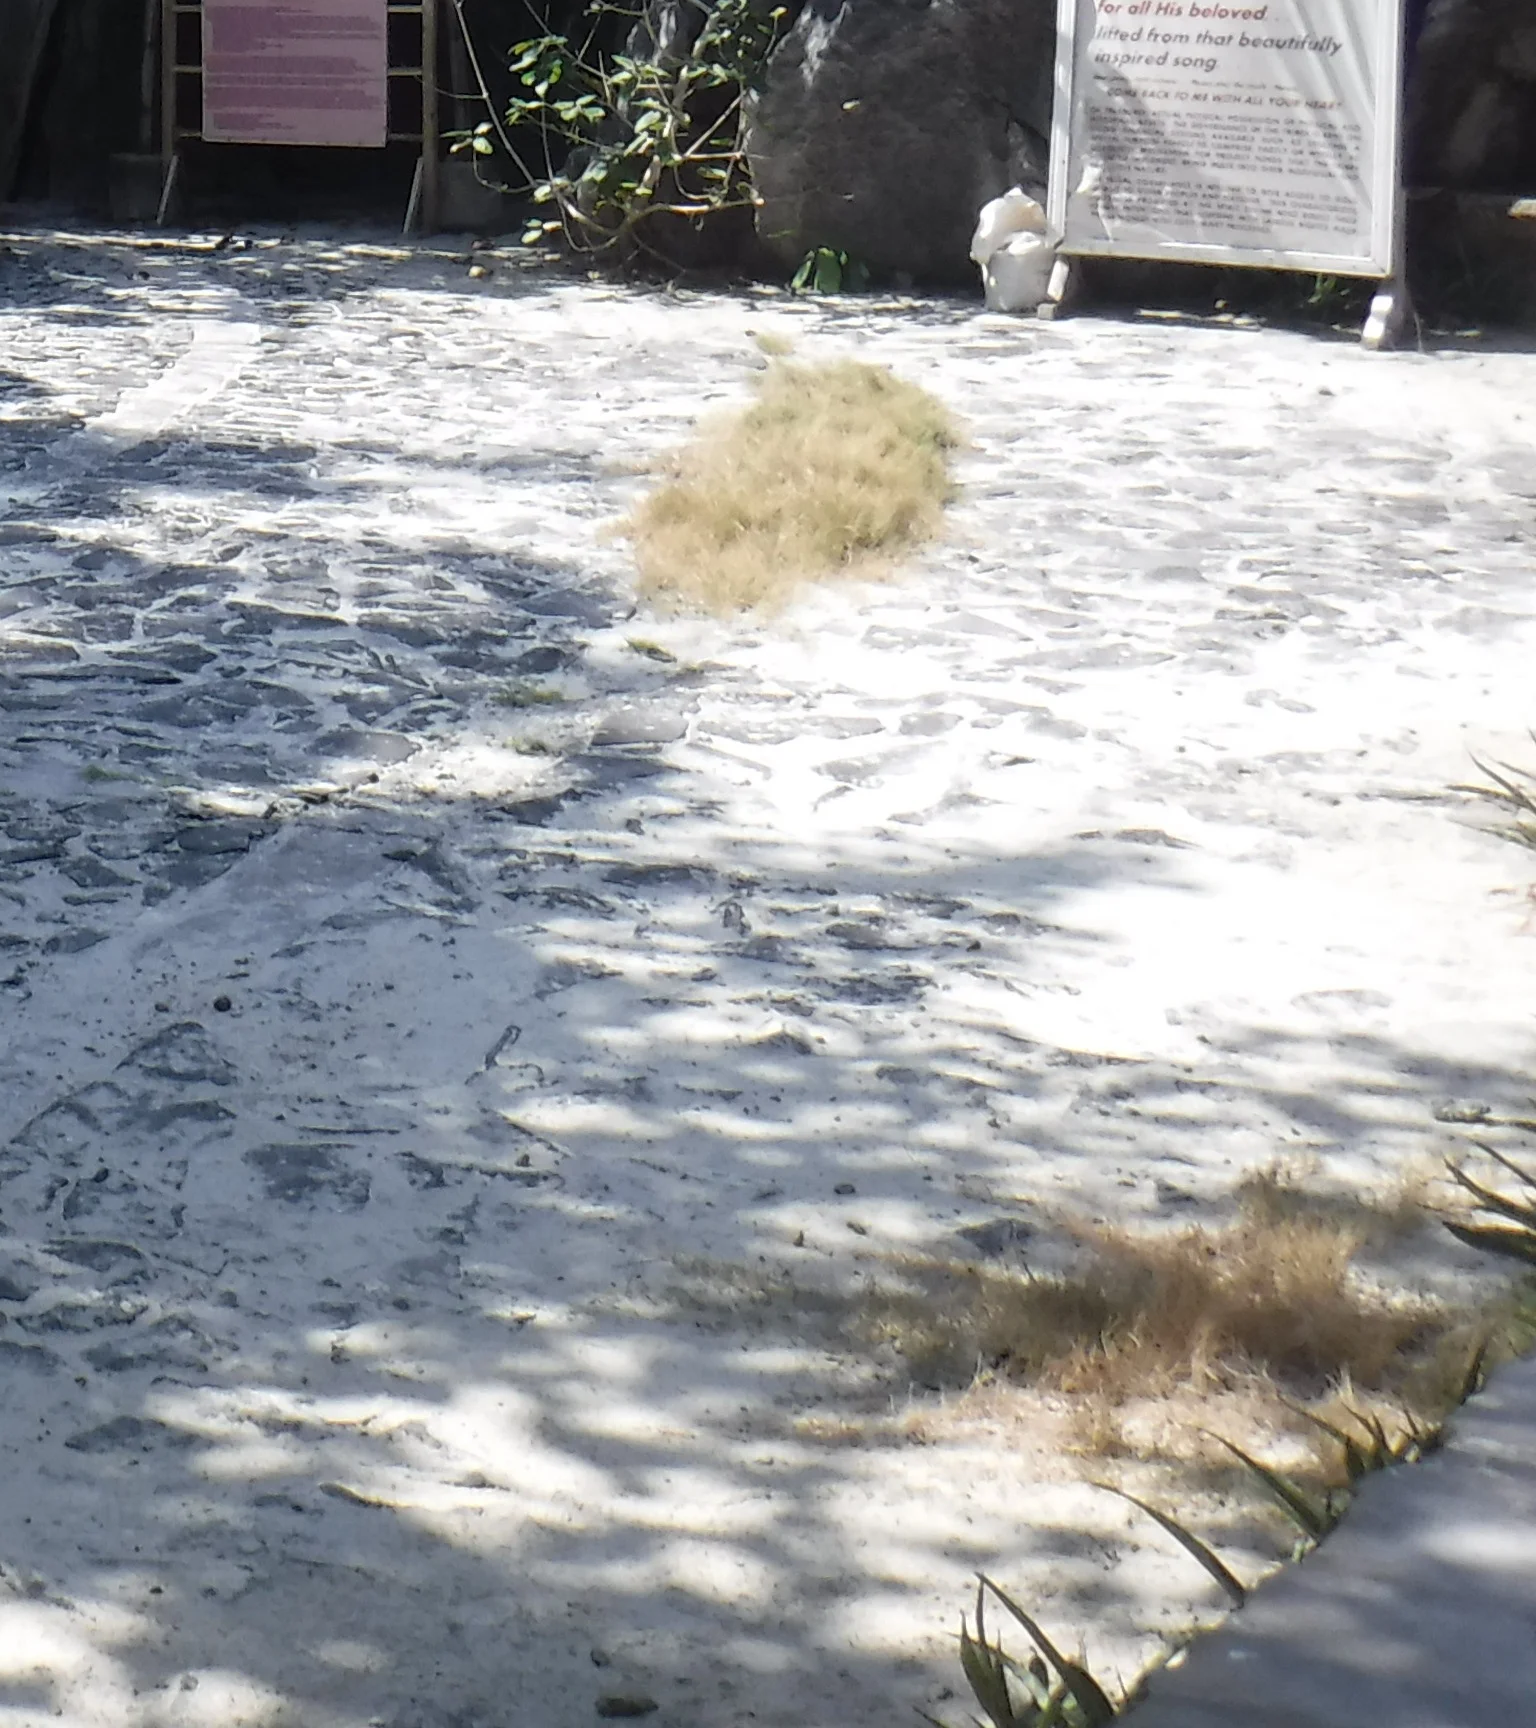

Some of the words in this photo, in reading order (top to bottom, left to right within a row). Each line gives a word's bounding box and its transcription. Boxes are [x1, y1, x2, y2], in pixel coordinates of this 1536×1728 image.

[1128, 0, 1152, 16] all
[1155, 1, 1183, 17] His
[1147, 27, 1190, 44] from
[1195, 30, 1234, 47] that
[1238, 32, 1343, 57] beautifully
[1094, 48, 1169, 68] inspired
[1172, 55, 1218, 73] song
